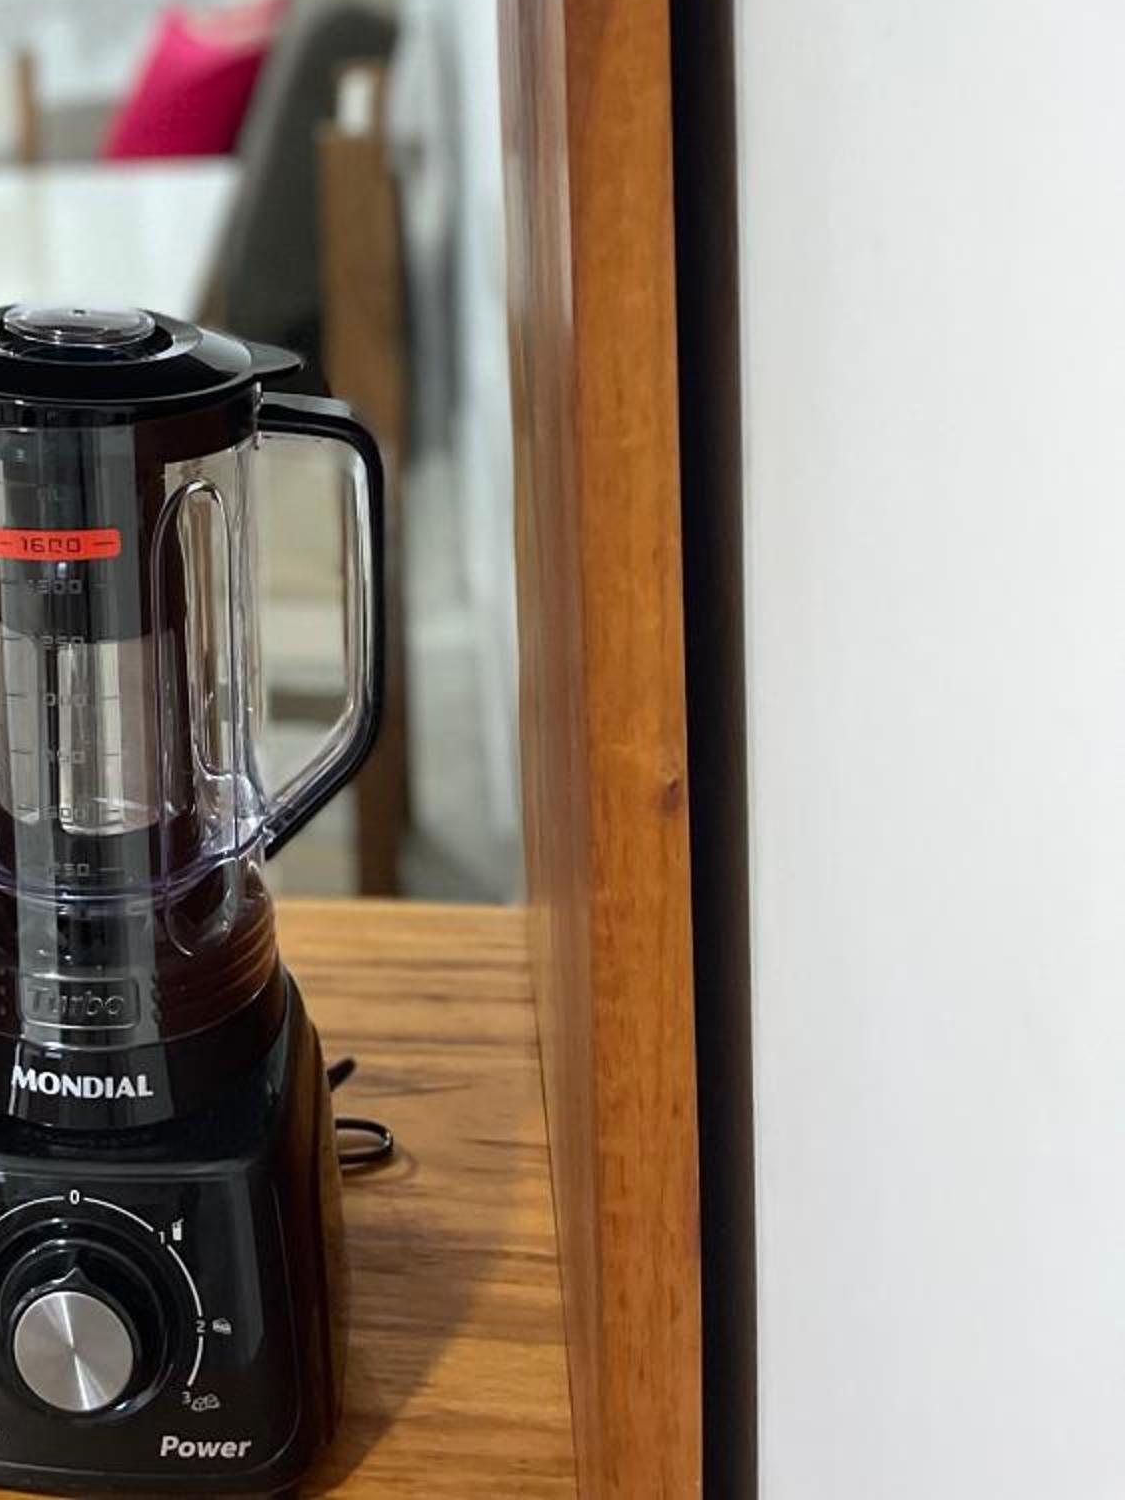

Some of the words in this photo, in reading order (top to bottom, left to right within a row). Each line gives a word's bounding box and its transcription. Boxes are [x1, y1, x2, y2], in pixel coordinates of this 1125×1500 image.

[11, 1065, 154, 1099] MONDIAL
[69, 1189, 80, 1205] 0
[158, 1230, 166, 1245] 1
[196, 1320, 206, 1333] 2
[181, 1391, 191, 1406] 3
[160, 1435, 252, 1459] Power
